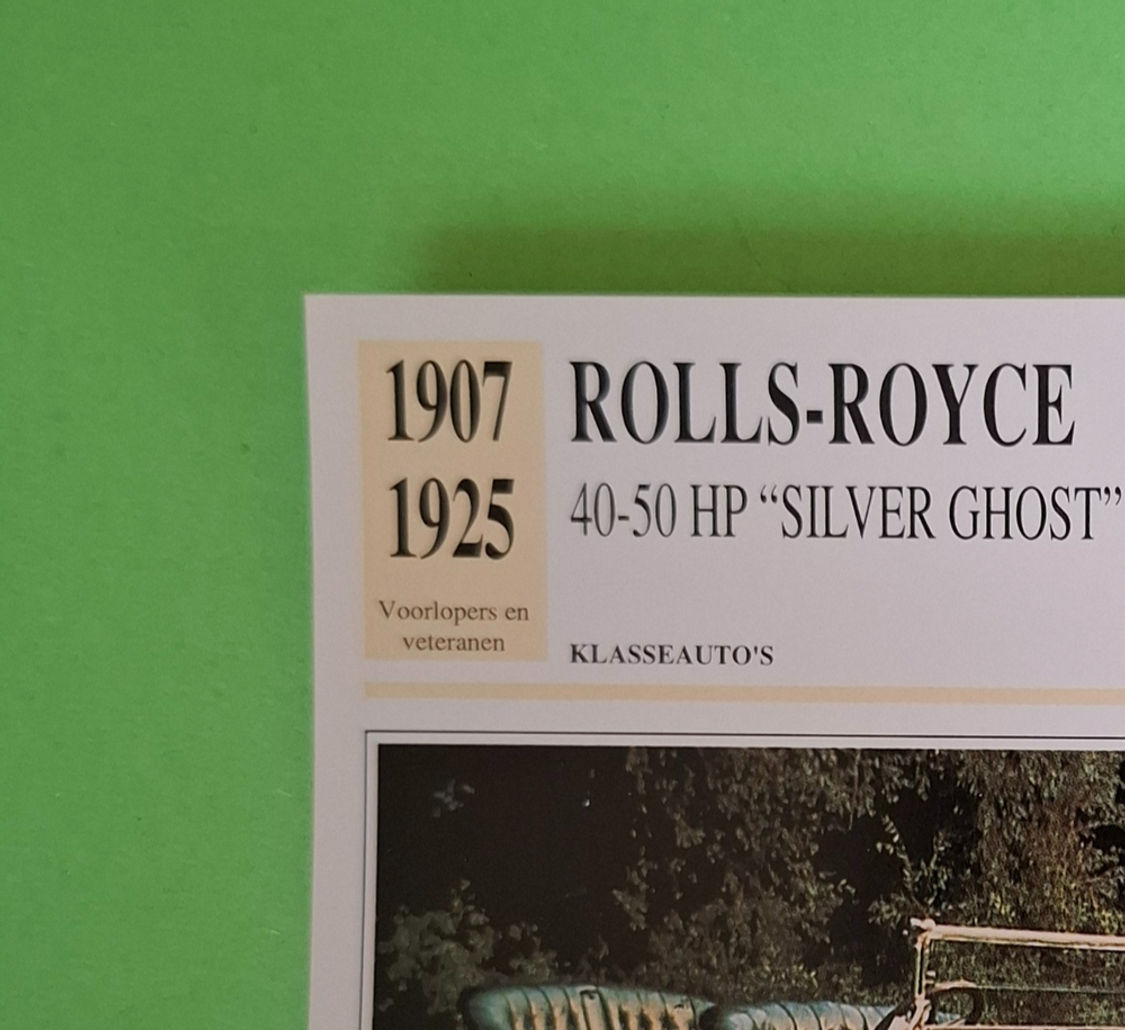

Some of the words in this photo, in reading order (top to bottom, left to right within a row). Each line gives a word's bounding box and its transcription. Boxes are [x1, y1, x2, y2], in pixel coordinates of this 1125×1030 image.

[385, 359, 513, 443] 1907
[568, 359, 1077, 447] ROLLS-ROYCE
[388, 476, 515, 560] 1925
[569, 482, 678, 538] 40-50
[690, 484, 749, 539] HP
[758, 484, 937, 541] “SILVER
[947, 485, 1124, 542] GHOST”
[378, 599, 499, 627] Voorlopers
[503, 605, 530, 622] en
[402, 634, 506, 653] veteranen
[569, 642, 775, 667] KLASSEAUTO'S
